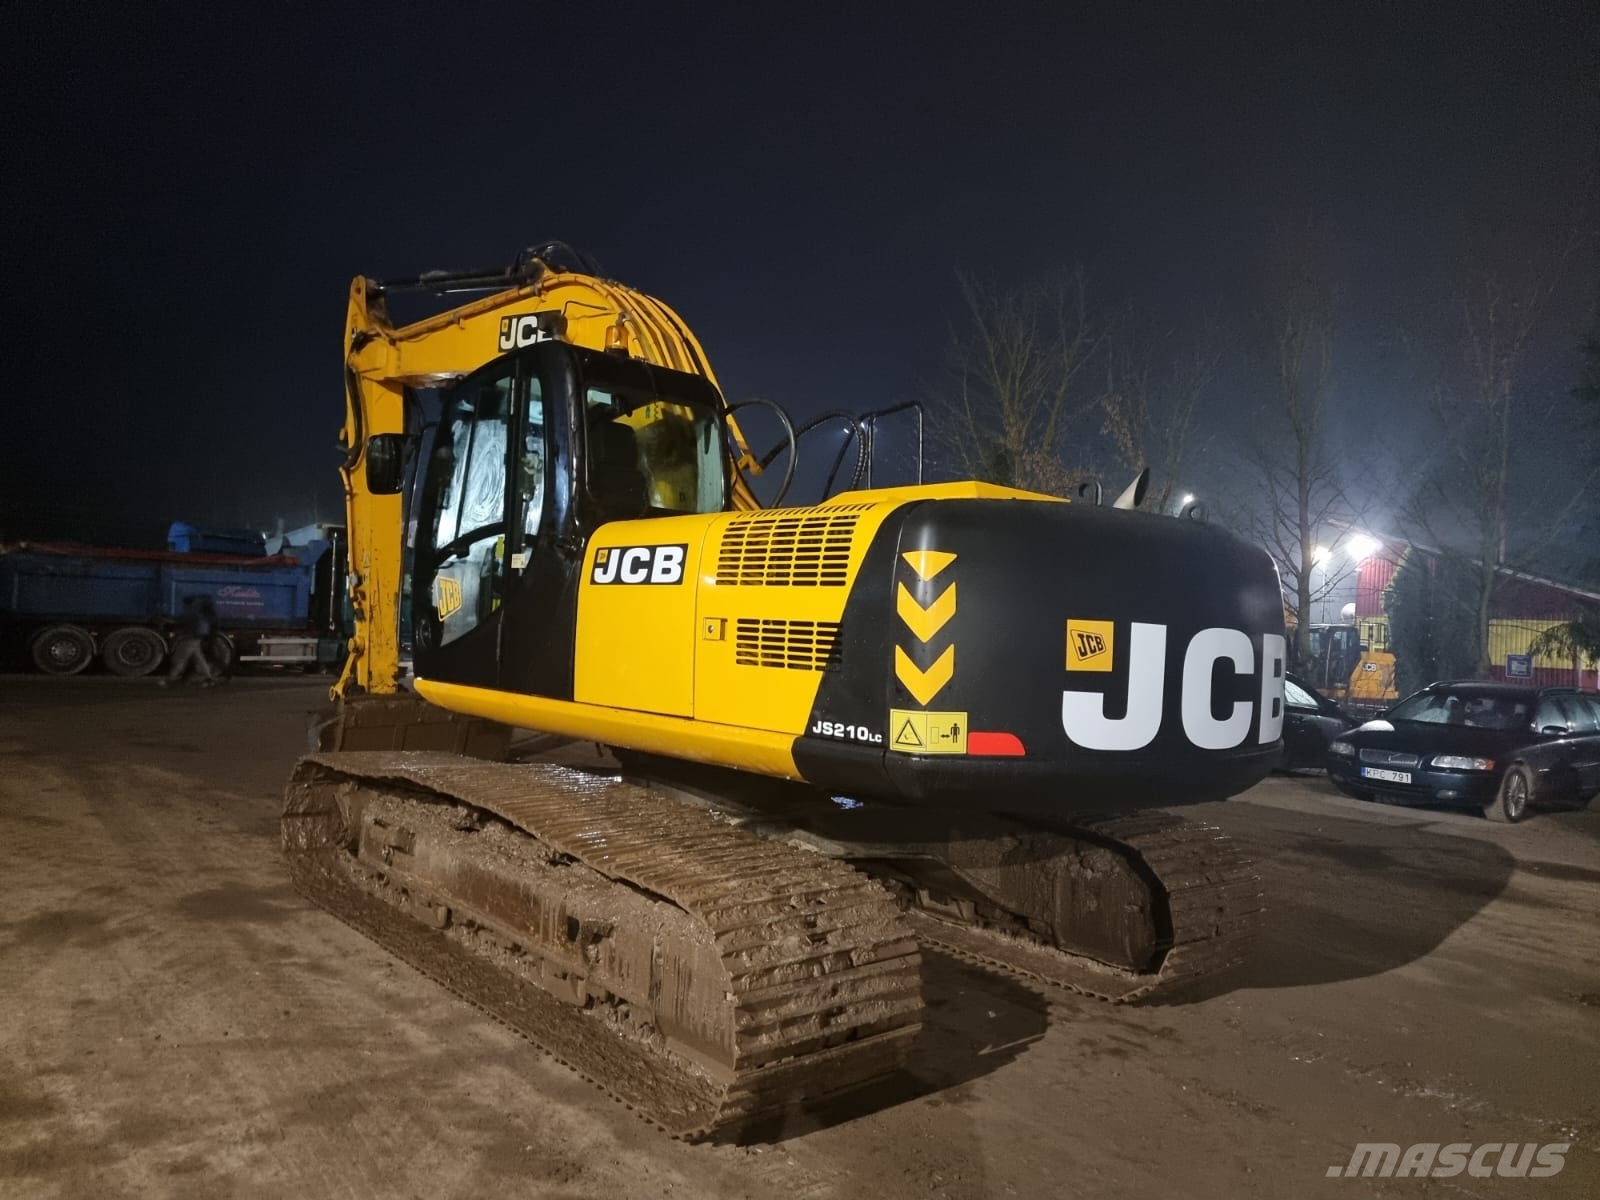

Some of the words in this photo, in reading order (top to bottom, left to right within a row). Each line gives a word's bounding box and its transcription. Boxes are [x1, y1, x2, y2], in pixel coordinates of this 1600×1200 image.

[593, 546, 684, 584] JCB
[438, 579, 461, 617] JCB
[1077, 632, 1104, 658] JCB
[1062, 621, 1286, 751] JCB
[1391, 771, 1410, 783] 791
